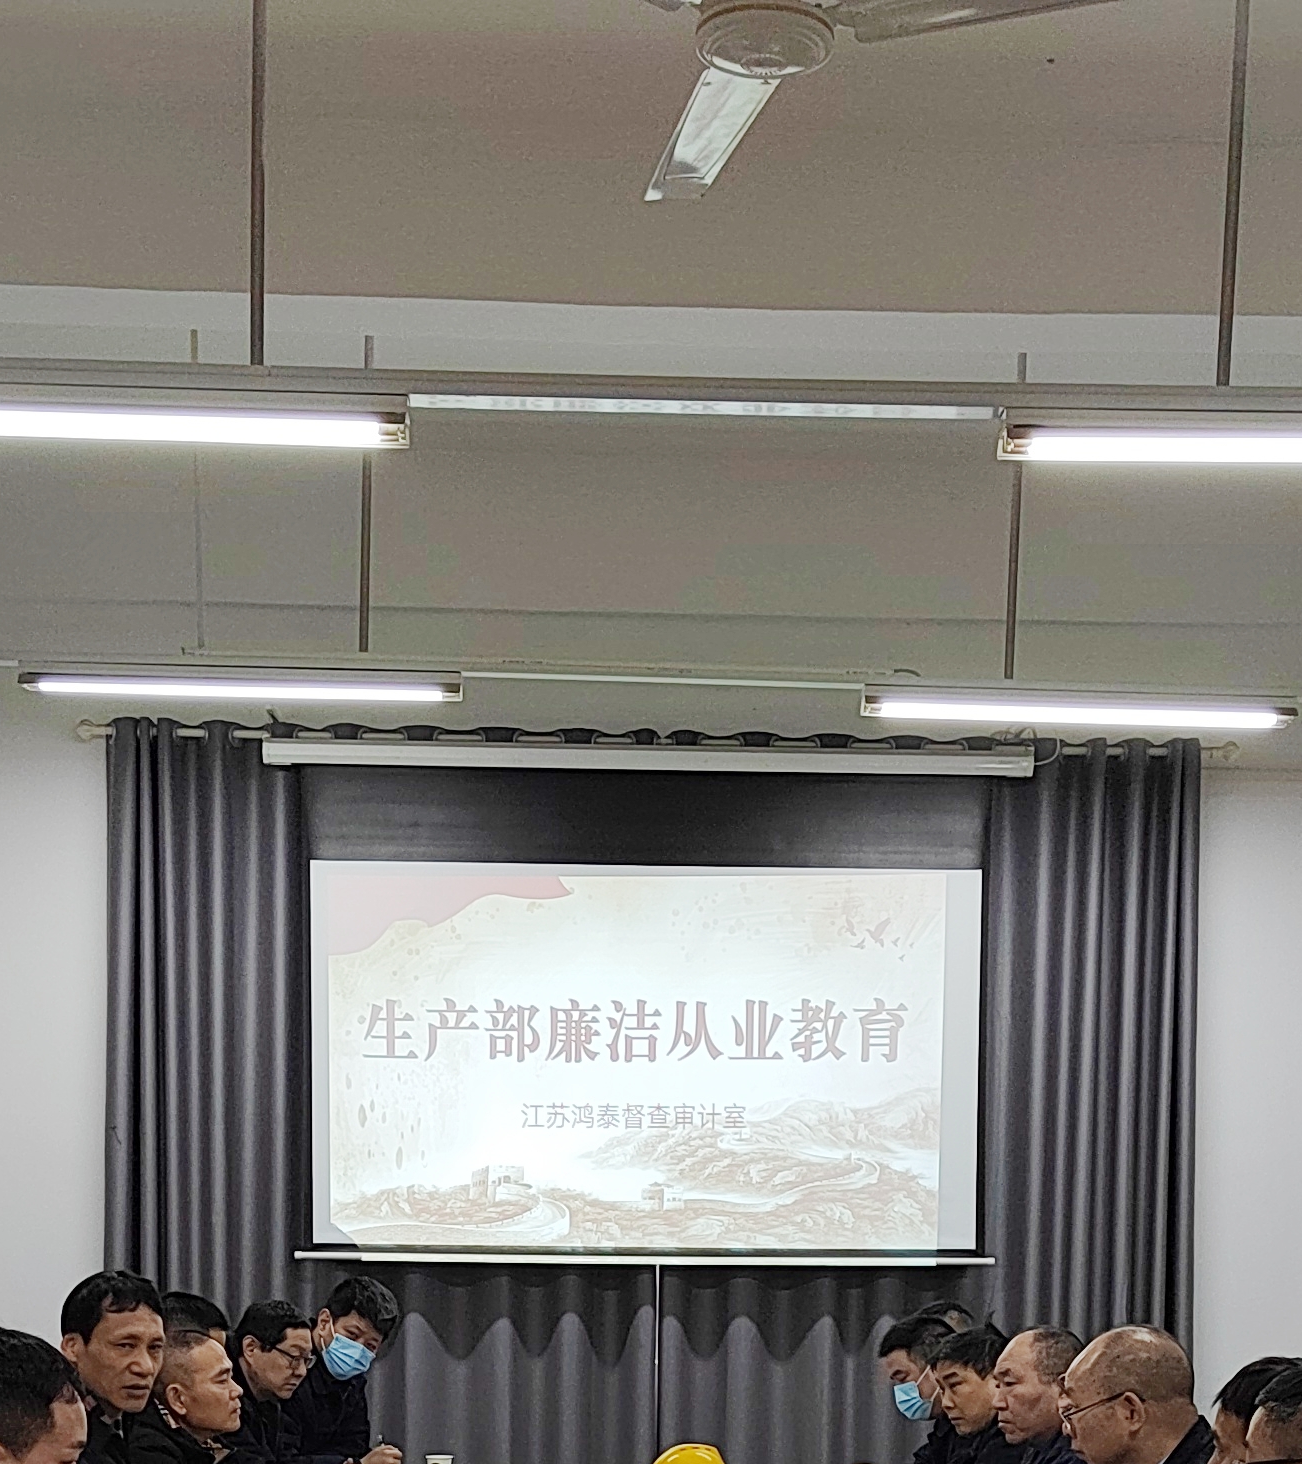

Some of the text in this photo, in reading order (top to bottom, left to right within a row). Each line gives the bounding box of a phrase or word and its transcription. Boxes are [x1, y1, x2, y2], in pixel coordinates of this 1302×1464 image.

[361, 997, 908, 1064] 生产部廉洁从业教育
[520, 1102, 748, 1131] 江苏鸿泰督查审计室
